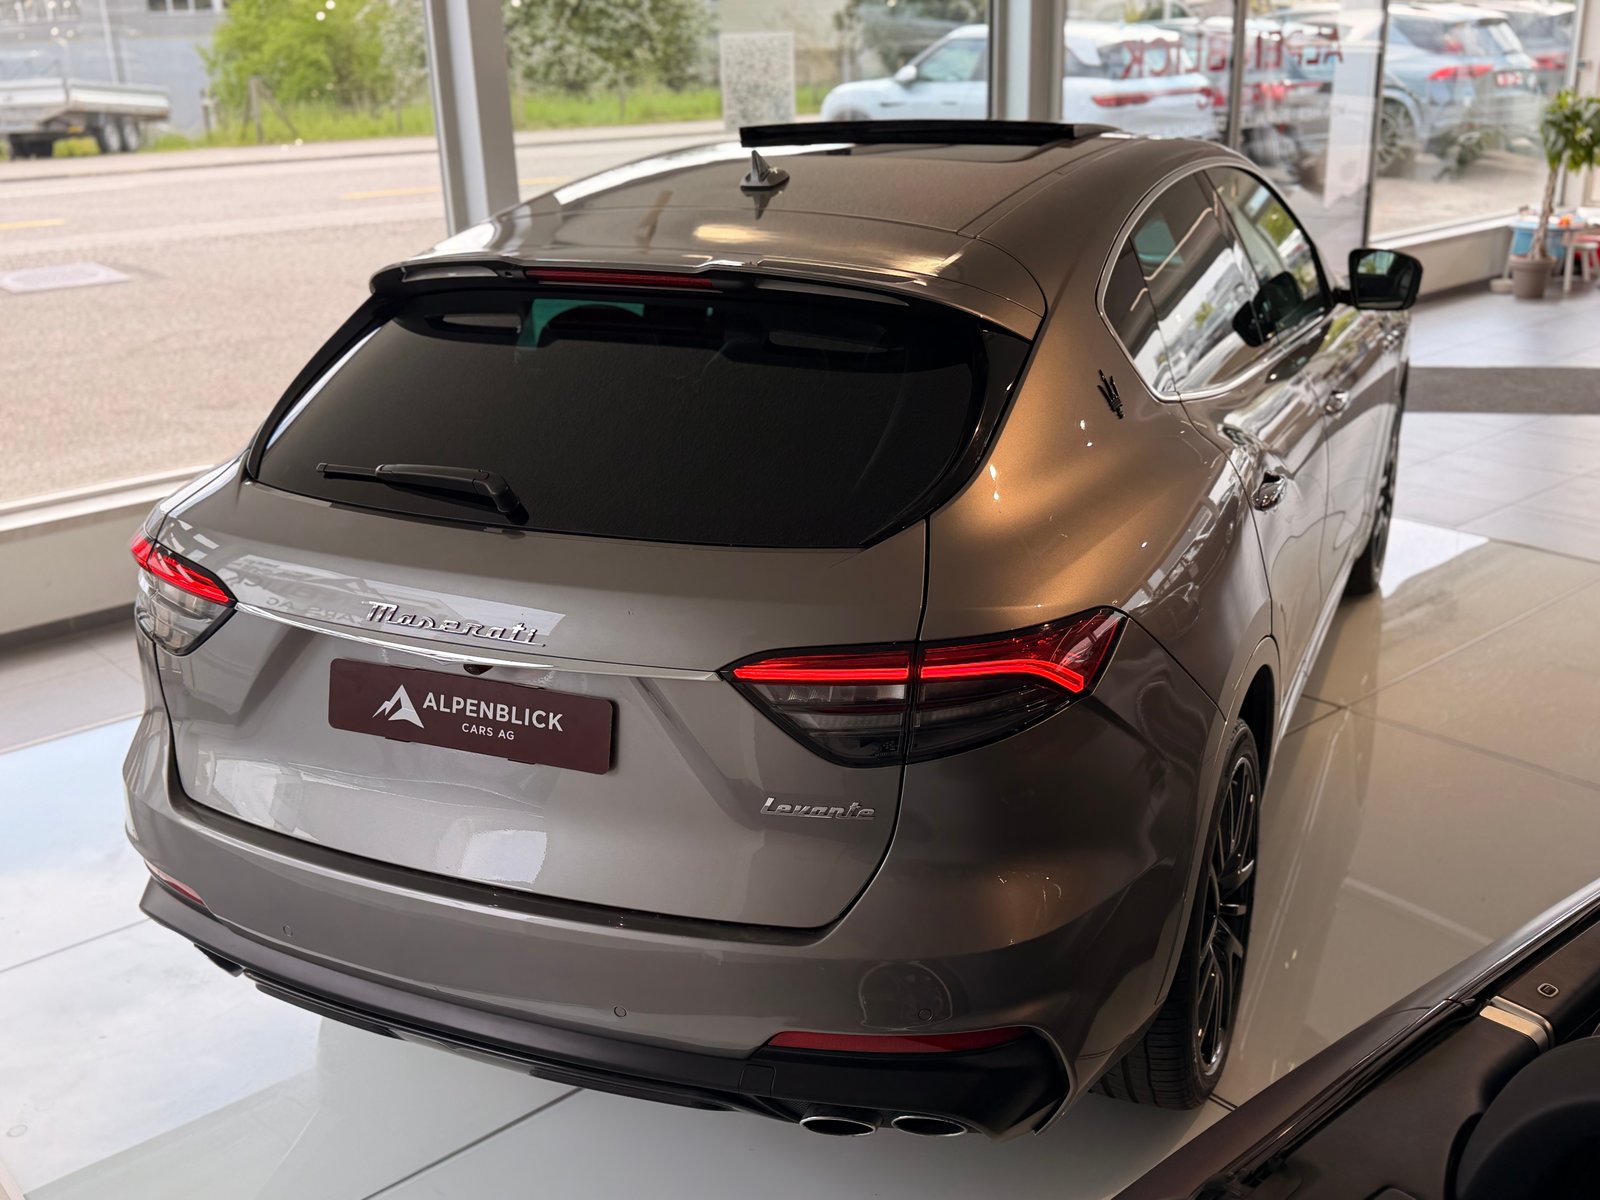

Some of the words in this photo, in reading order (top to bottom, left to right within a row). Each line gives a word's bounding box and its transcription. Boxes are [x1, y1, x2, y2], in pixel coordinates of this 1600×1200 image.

[361, 600, 547, 648] Maserati
[423, 691, 563, 732] ALPENBLICK
[461, 722, 493, 737] CARS
[498, 729, 515, 741] AG
[760, 797, 876, 820] Levante
